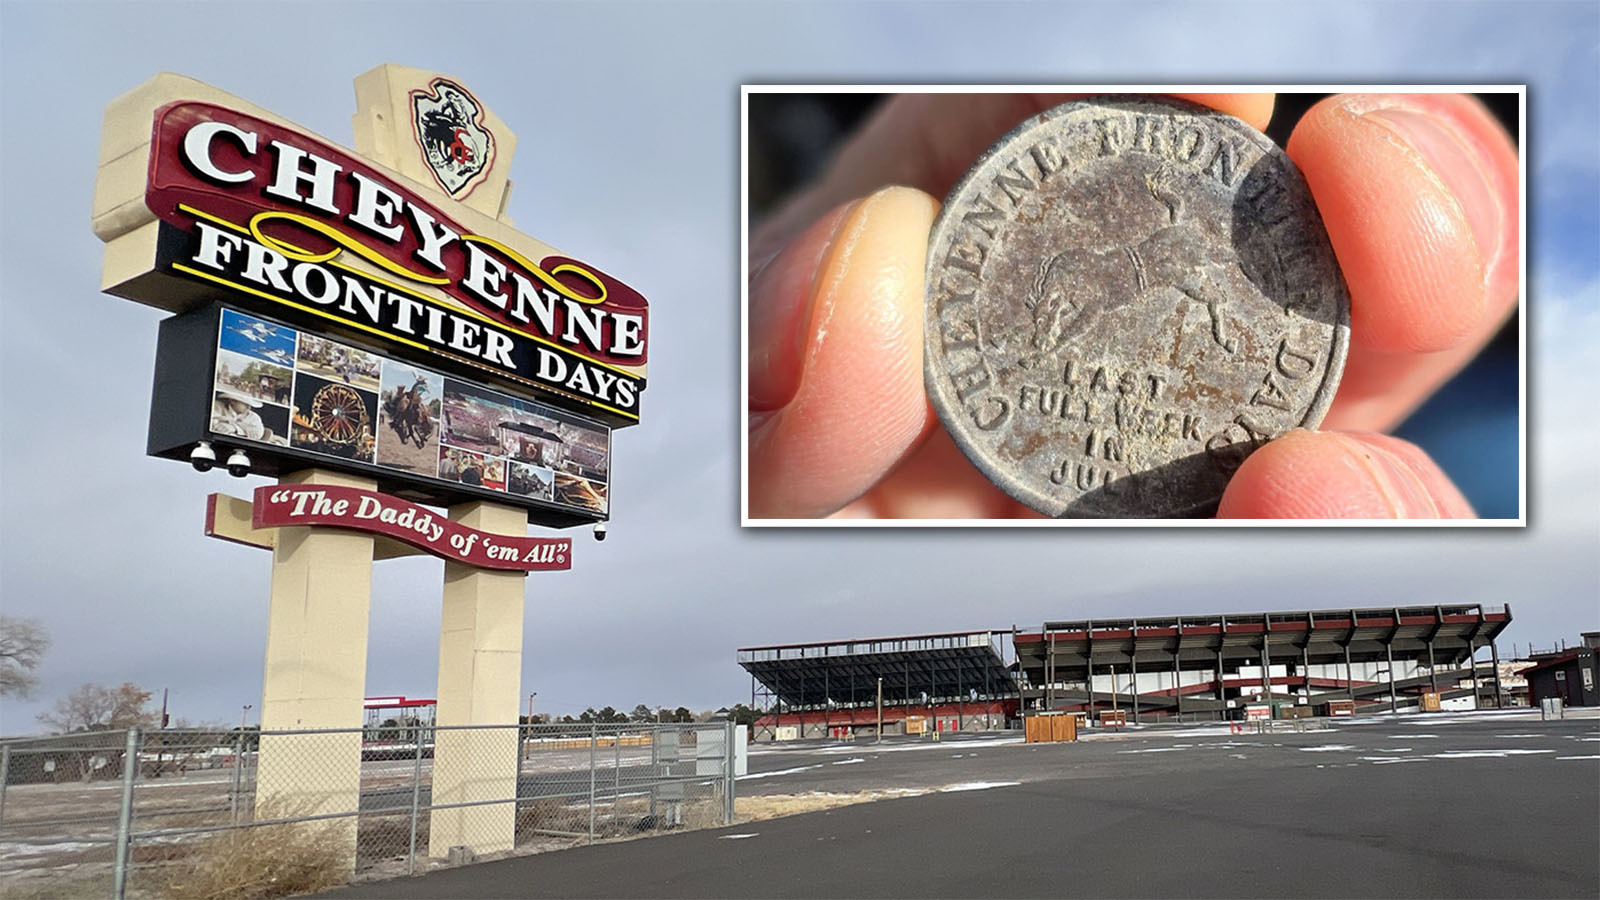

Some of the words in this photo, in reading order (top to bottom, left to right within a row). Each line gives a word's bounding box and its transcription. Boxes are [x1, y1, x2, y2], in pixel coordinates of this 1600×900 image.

[183, 121, 645, 356] CHEYENNE
[193, 222, 517, 369] FRONTIER
[535, 347, 636, 408] DAYS
[936, 144, 1069, 432] CHEYENNE
[1020, 383, 1104, 424] FULL
[1114, 400, 1203, 442] WEEK
[1063, 360, 1168, 401] LAST
[1085, 427, 1125, 462] IN
[1050, 460, 1140, 498] JUL
[270, 489, 348, 516] “The
[354, 497, 445, 541] Daddy
[450, 533, 479, 556] of
[482, 538, 519, 561] ‘em
